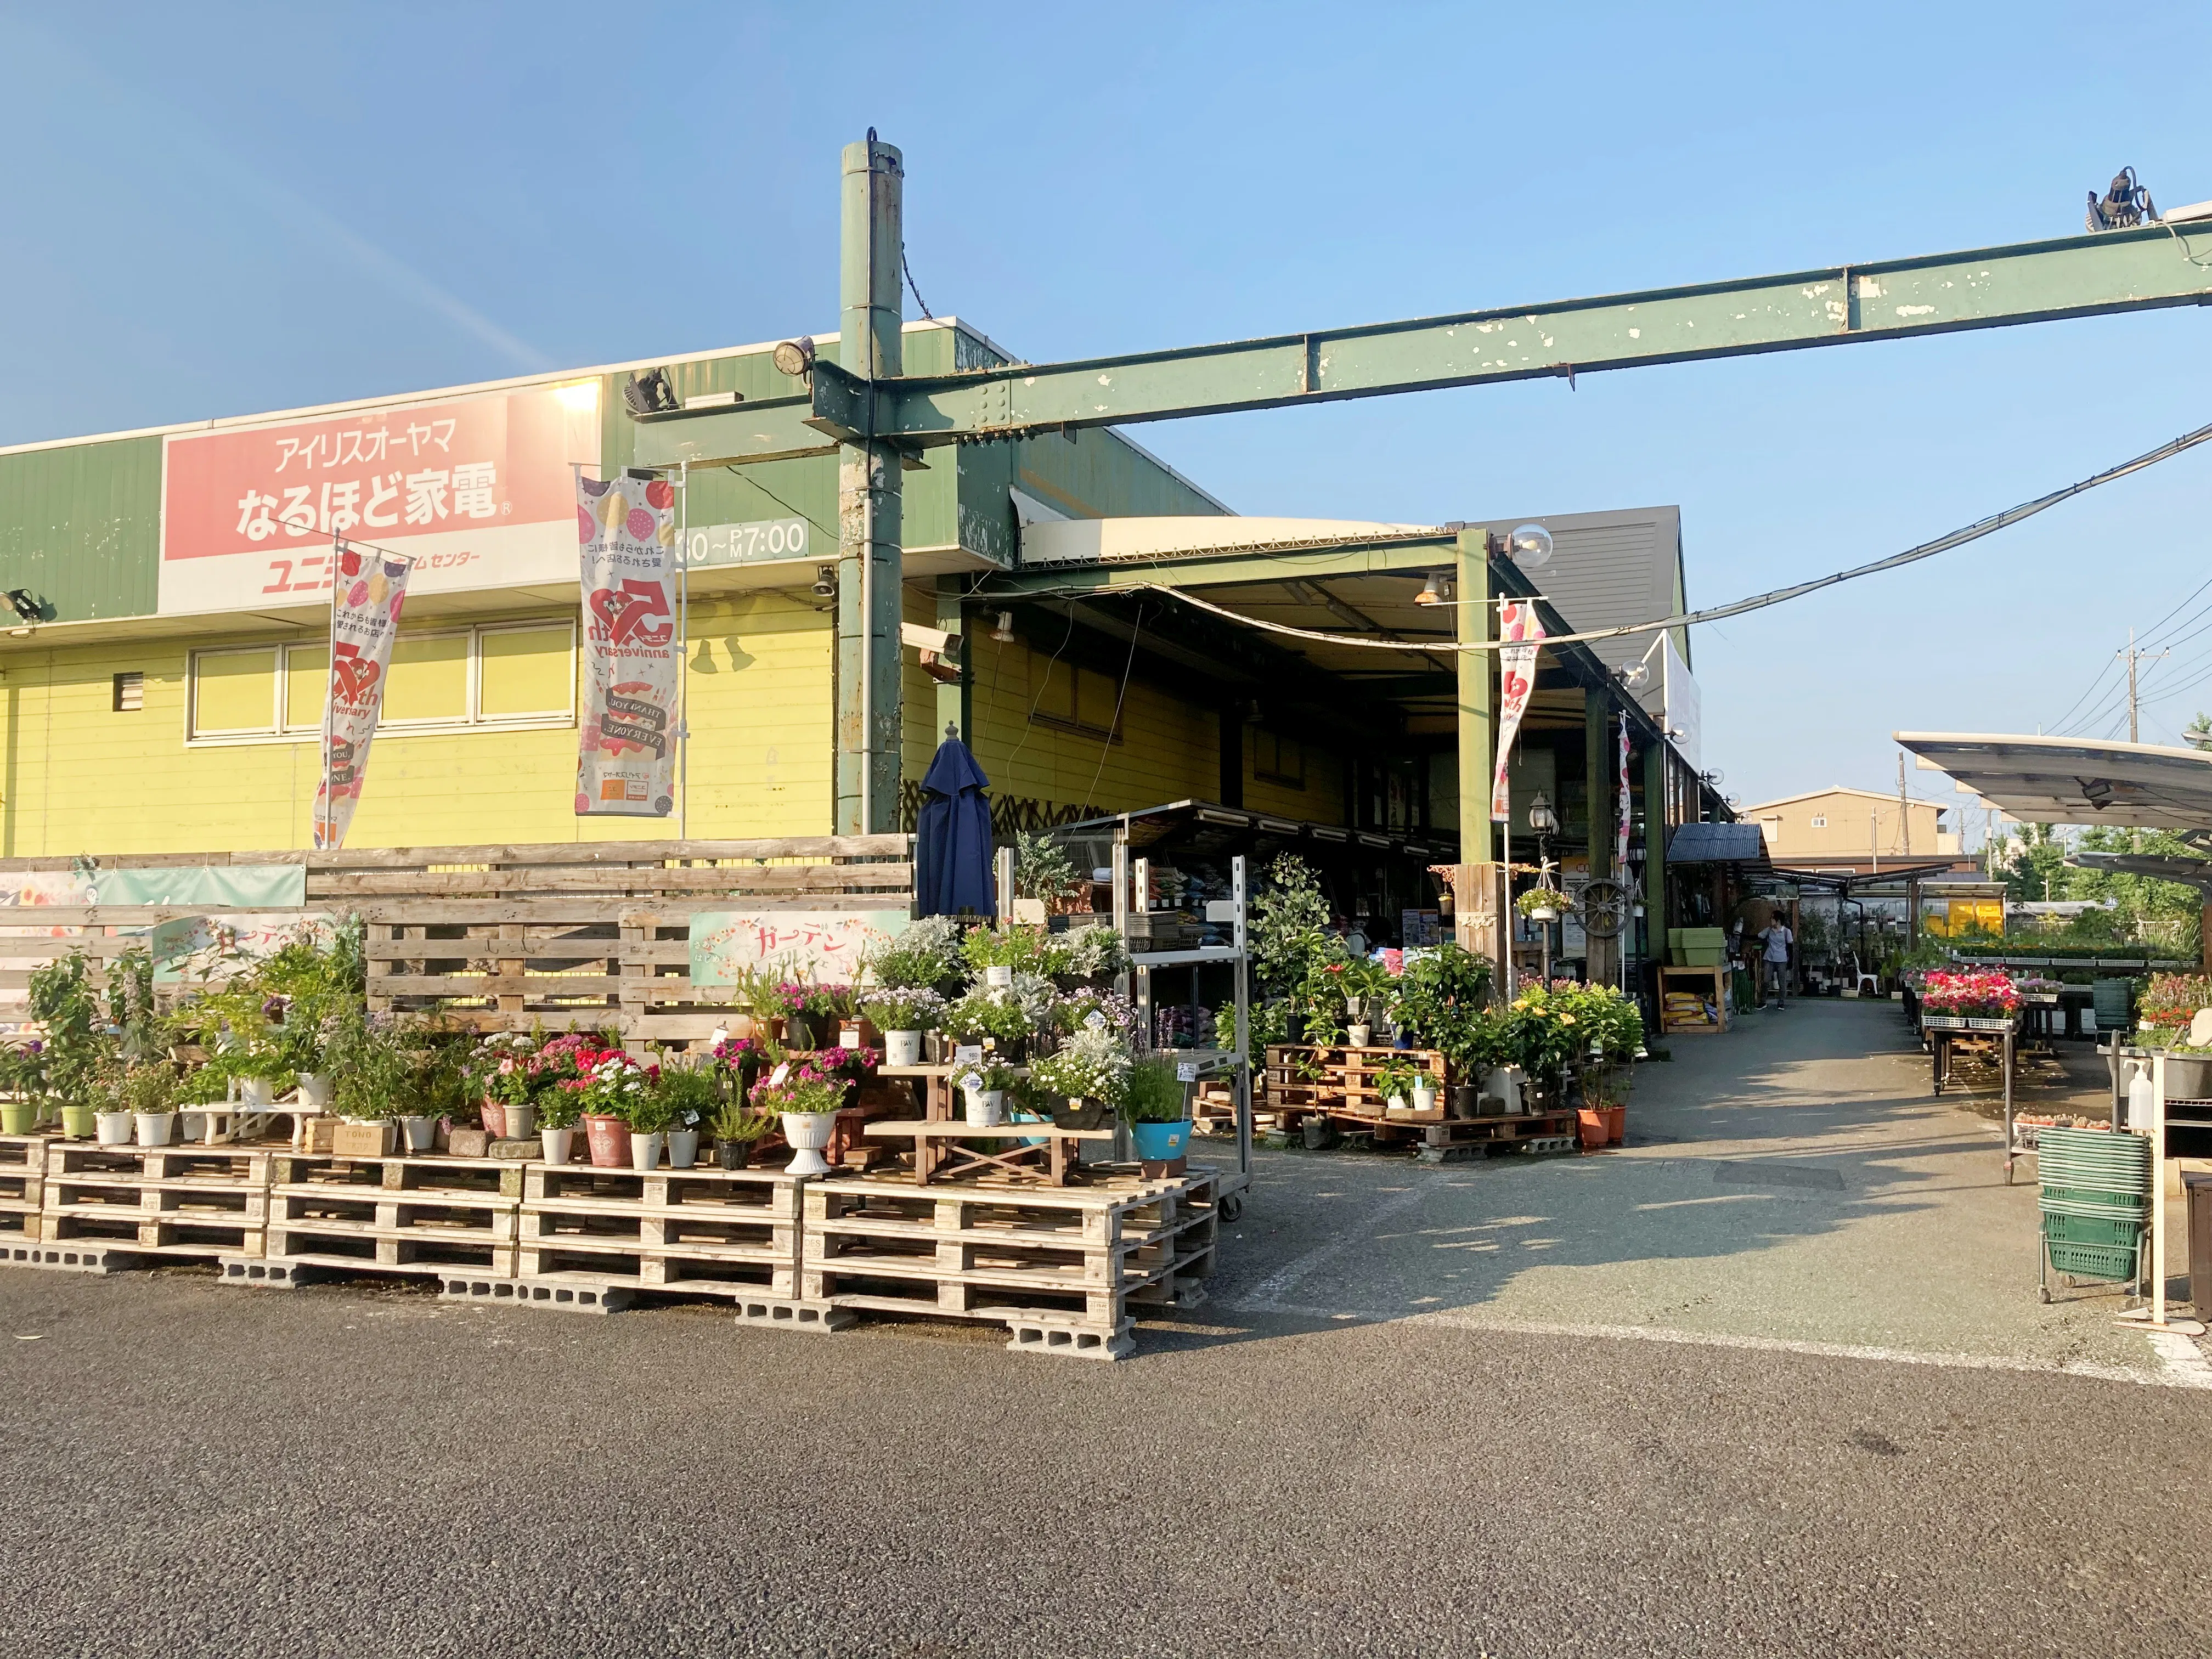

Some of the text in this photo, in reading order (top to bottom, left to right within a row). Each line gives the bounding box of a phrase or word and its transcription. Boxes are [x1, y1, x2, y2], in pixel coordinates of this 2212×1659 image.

[275, 418, 456, 472] アイリスオーヤマ
[755, 923, 847, 958] ガーデン
